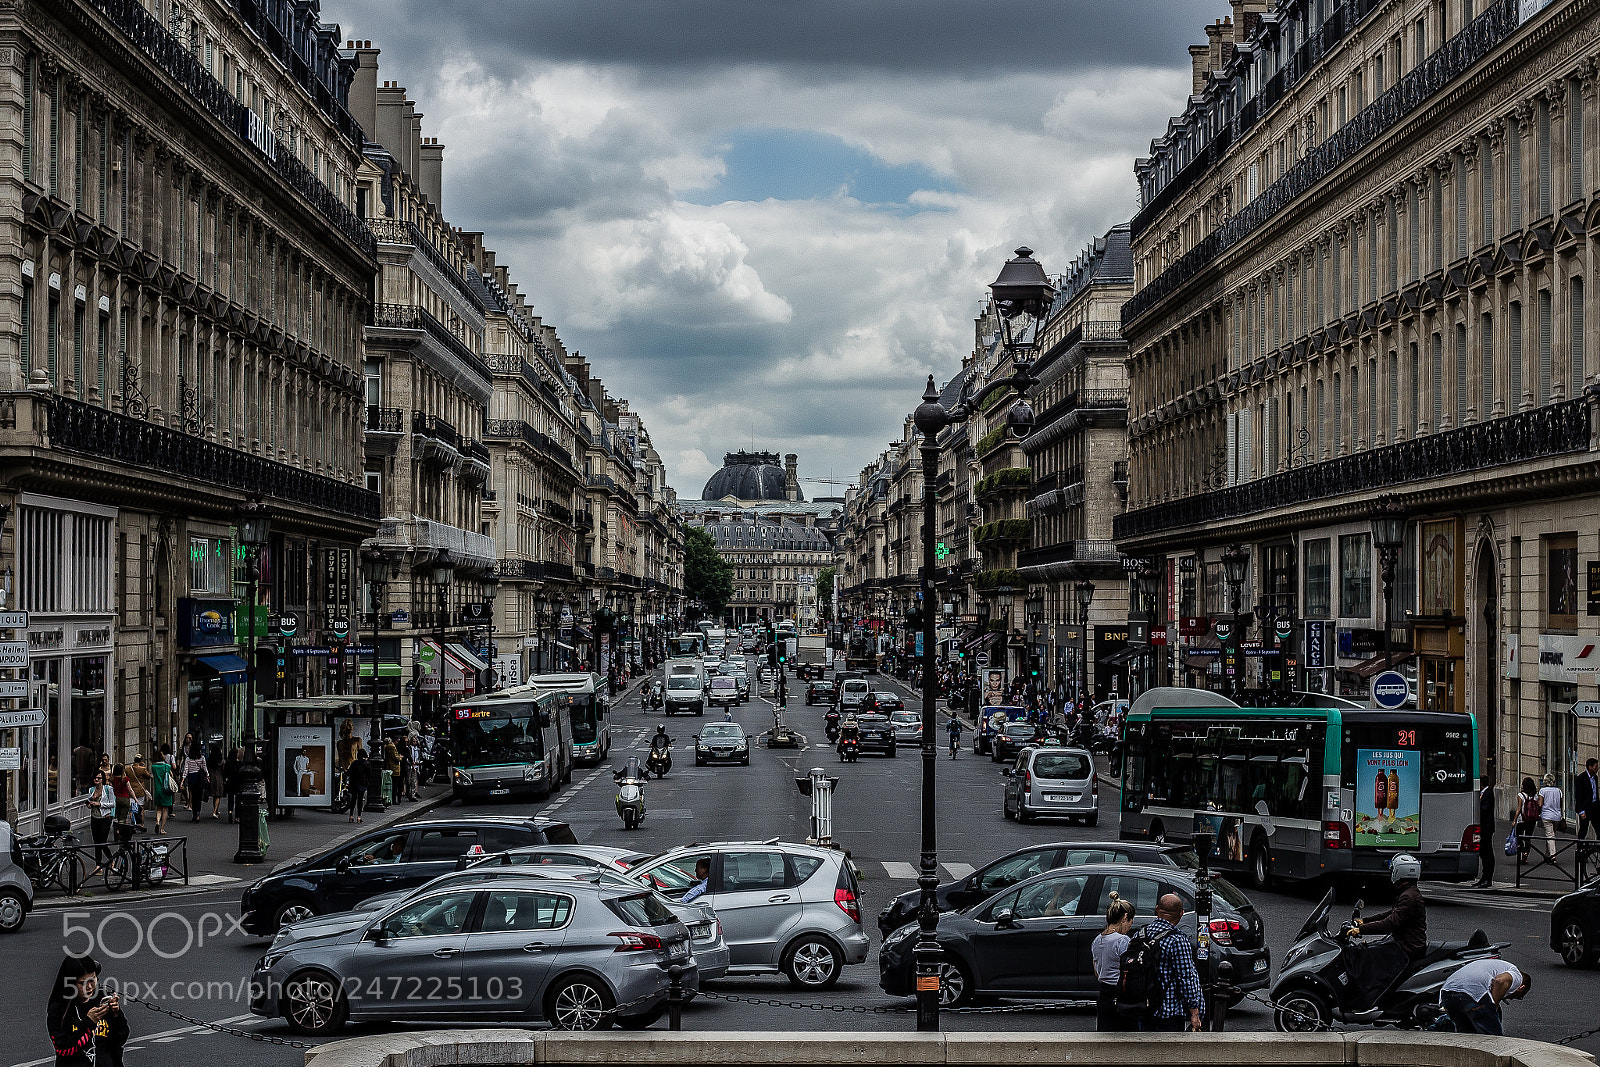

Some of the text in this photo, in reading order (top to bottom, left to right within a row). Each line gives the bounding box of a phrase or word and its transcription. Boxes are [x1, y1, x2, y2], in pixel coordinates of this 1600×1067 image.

[280, 617, 296, 626] BUS
[334, 621, 348, 629] BUS
[1276, 620, 1291, 629] BUS
[1216, 624, 1230, 632] BUS
[1104, 632, 1129, 641] BNP
[1150, 631, 1166, 639] SFR
[1311, 623, 1321, 666] CHANGE
[458, 710, 470, 718] 95
[1398, 730, 1416, 746] 21
[1341, 810, 1352, 820] 70
